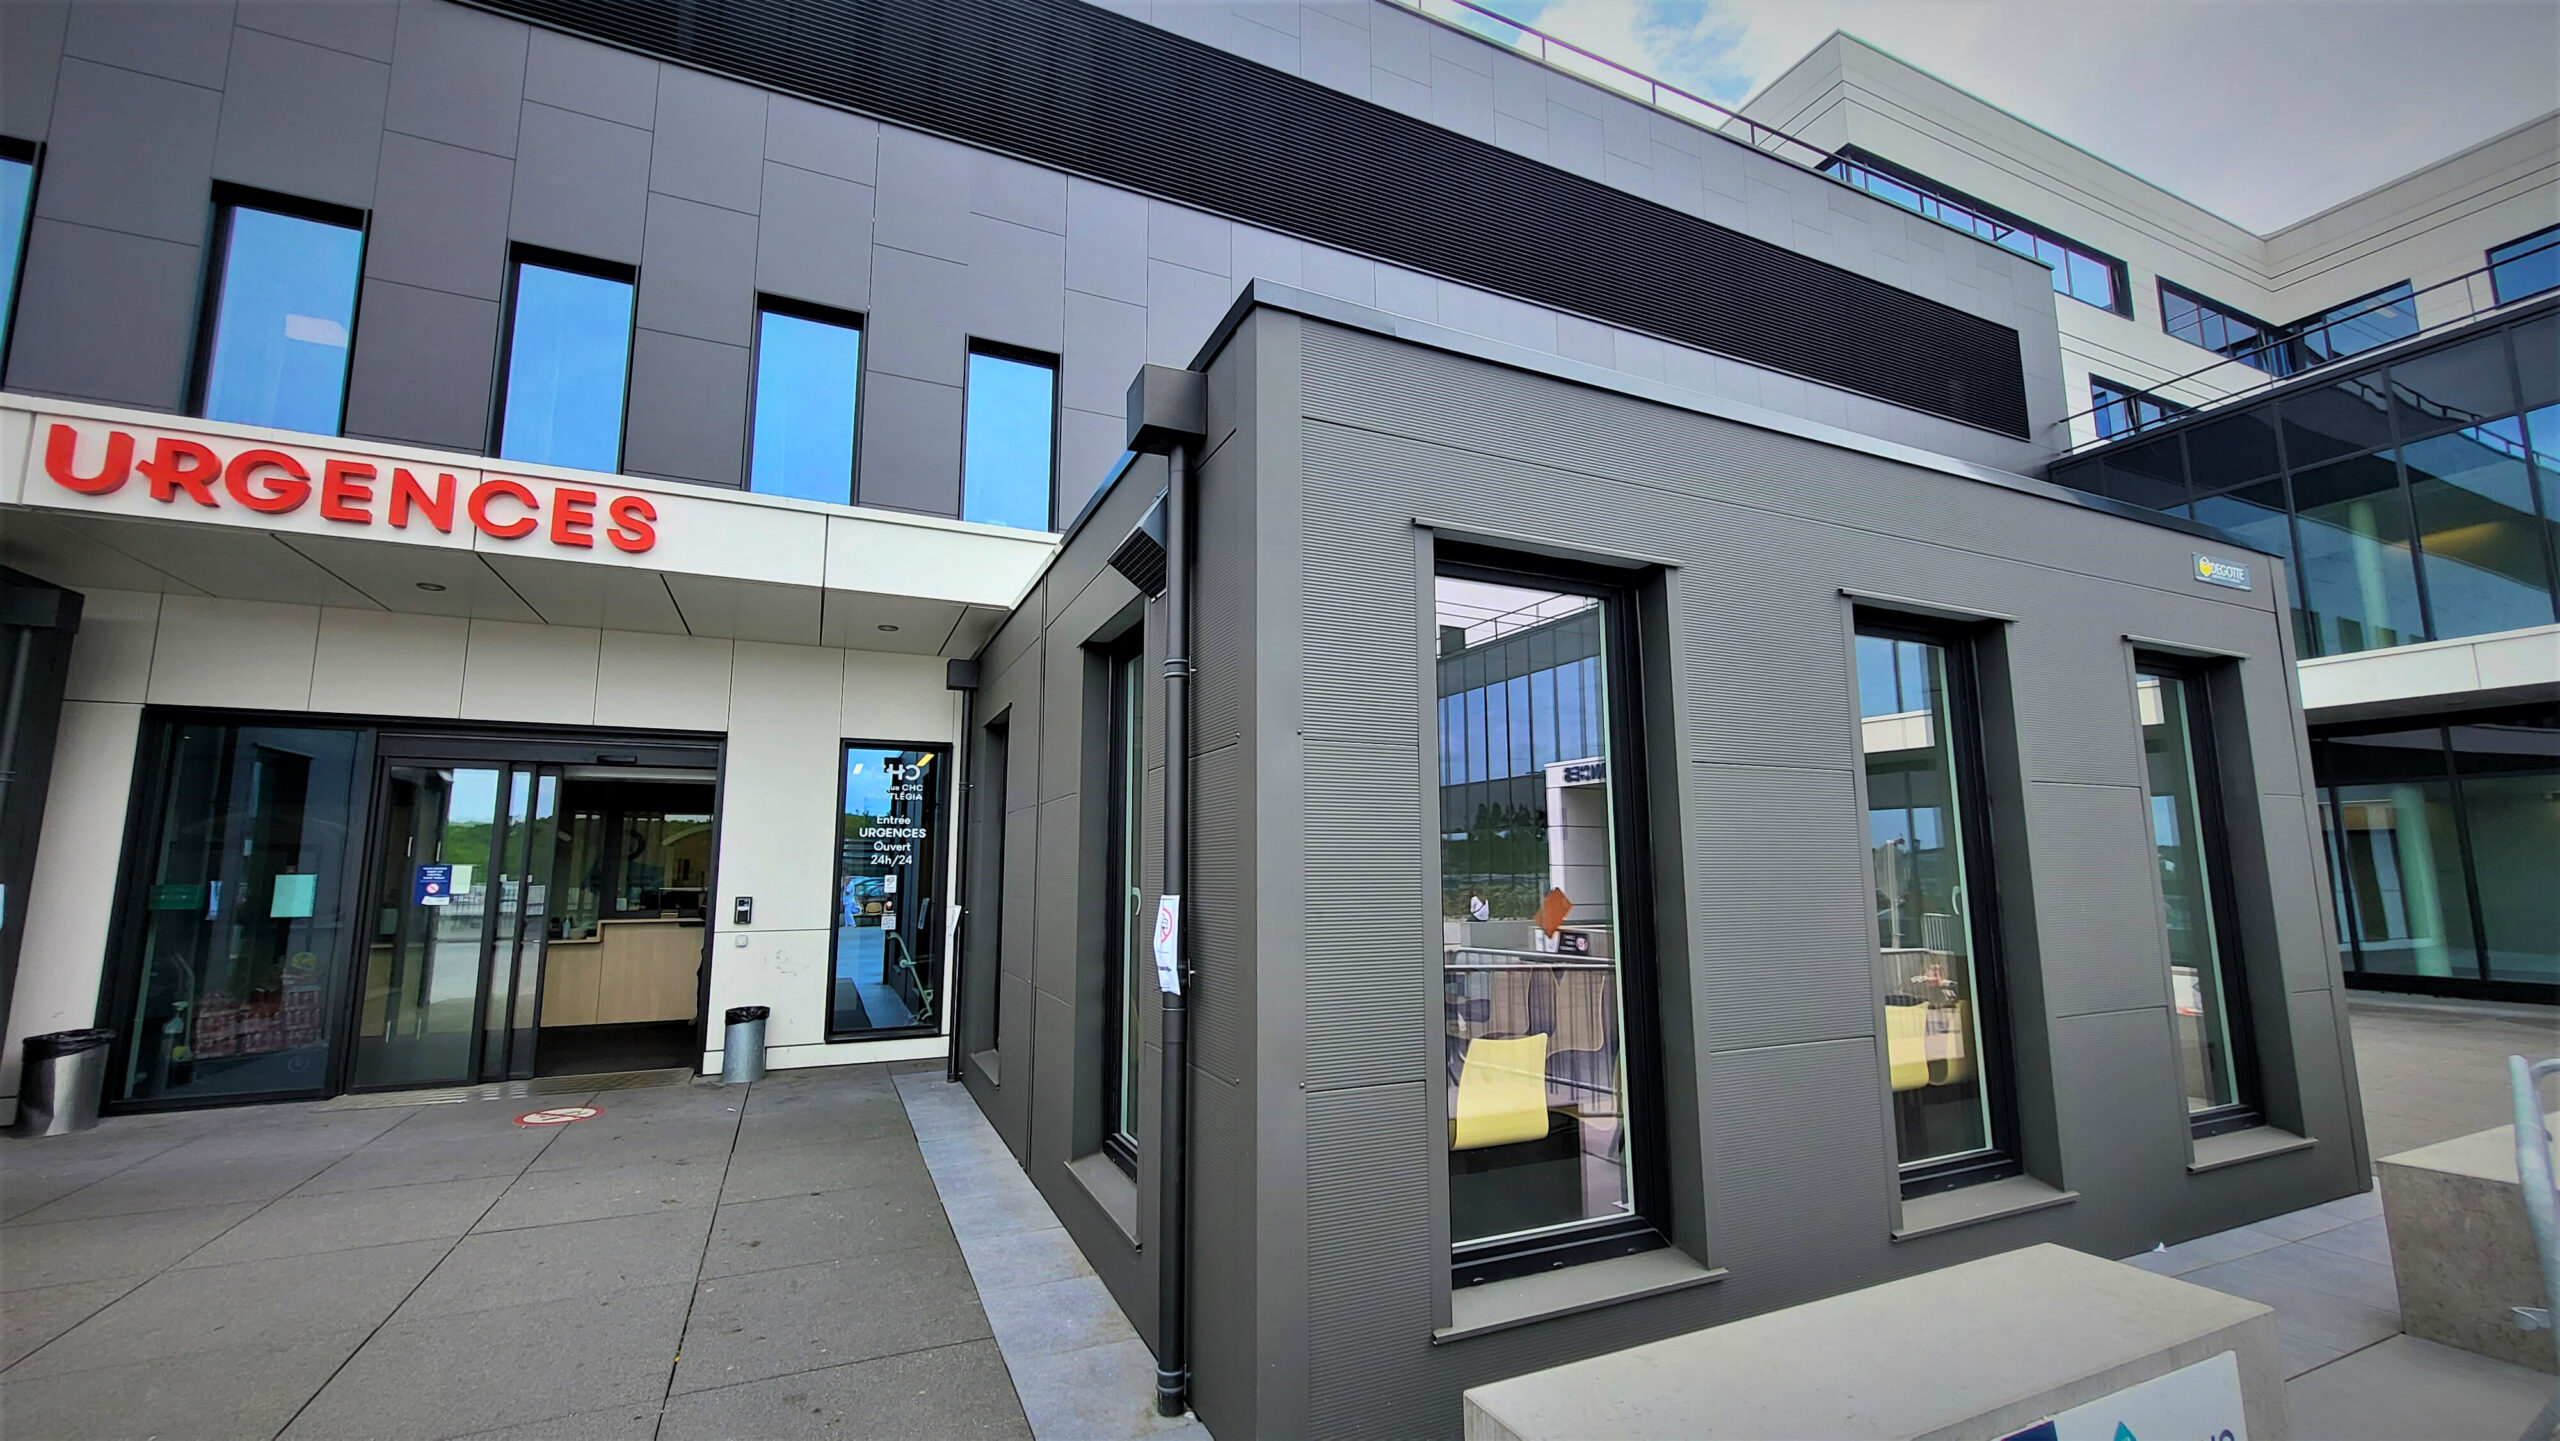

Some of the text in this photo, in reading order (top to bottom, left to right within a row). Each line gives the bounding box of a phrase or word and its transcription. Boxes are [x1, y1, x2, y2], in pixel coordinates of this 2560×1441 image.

[44, 423, 657, 554] URGENCES
[2210, 562, 2245, 581] DEGOTTE
[901, 784, 924, 792] CHC
[889, 792, 923, 801] TLÉGIA
[876, 815, 911, 825] Entrée
[859, 827, 927, 838] URGENCES
[873, 841, 911, 852] Ouvert
[870, 854, 913, 867] 24h/24
